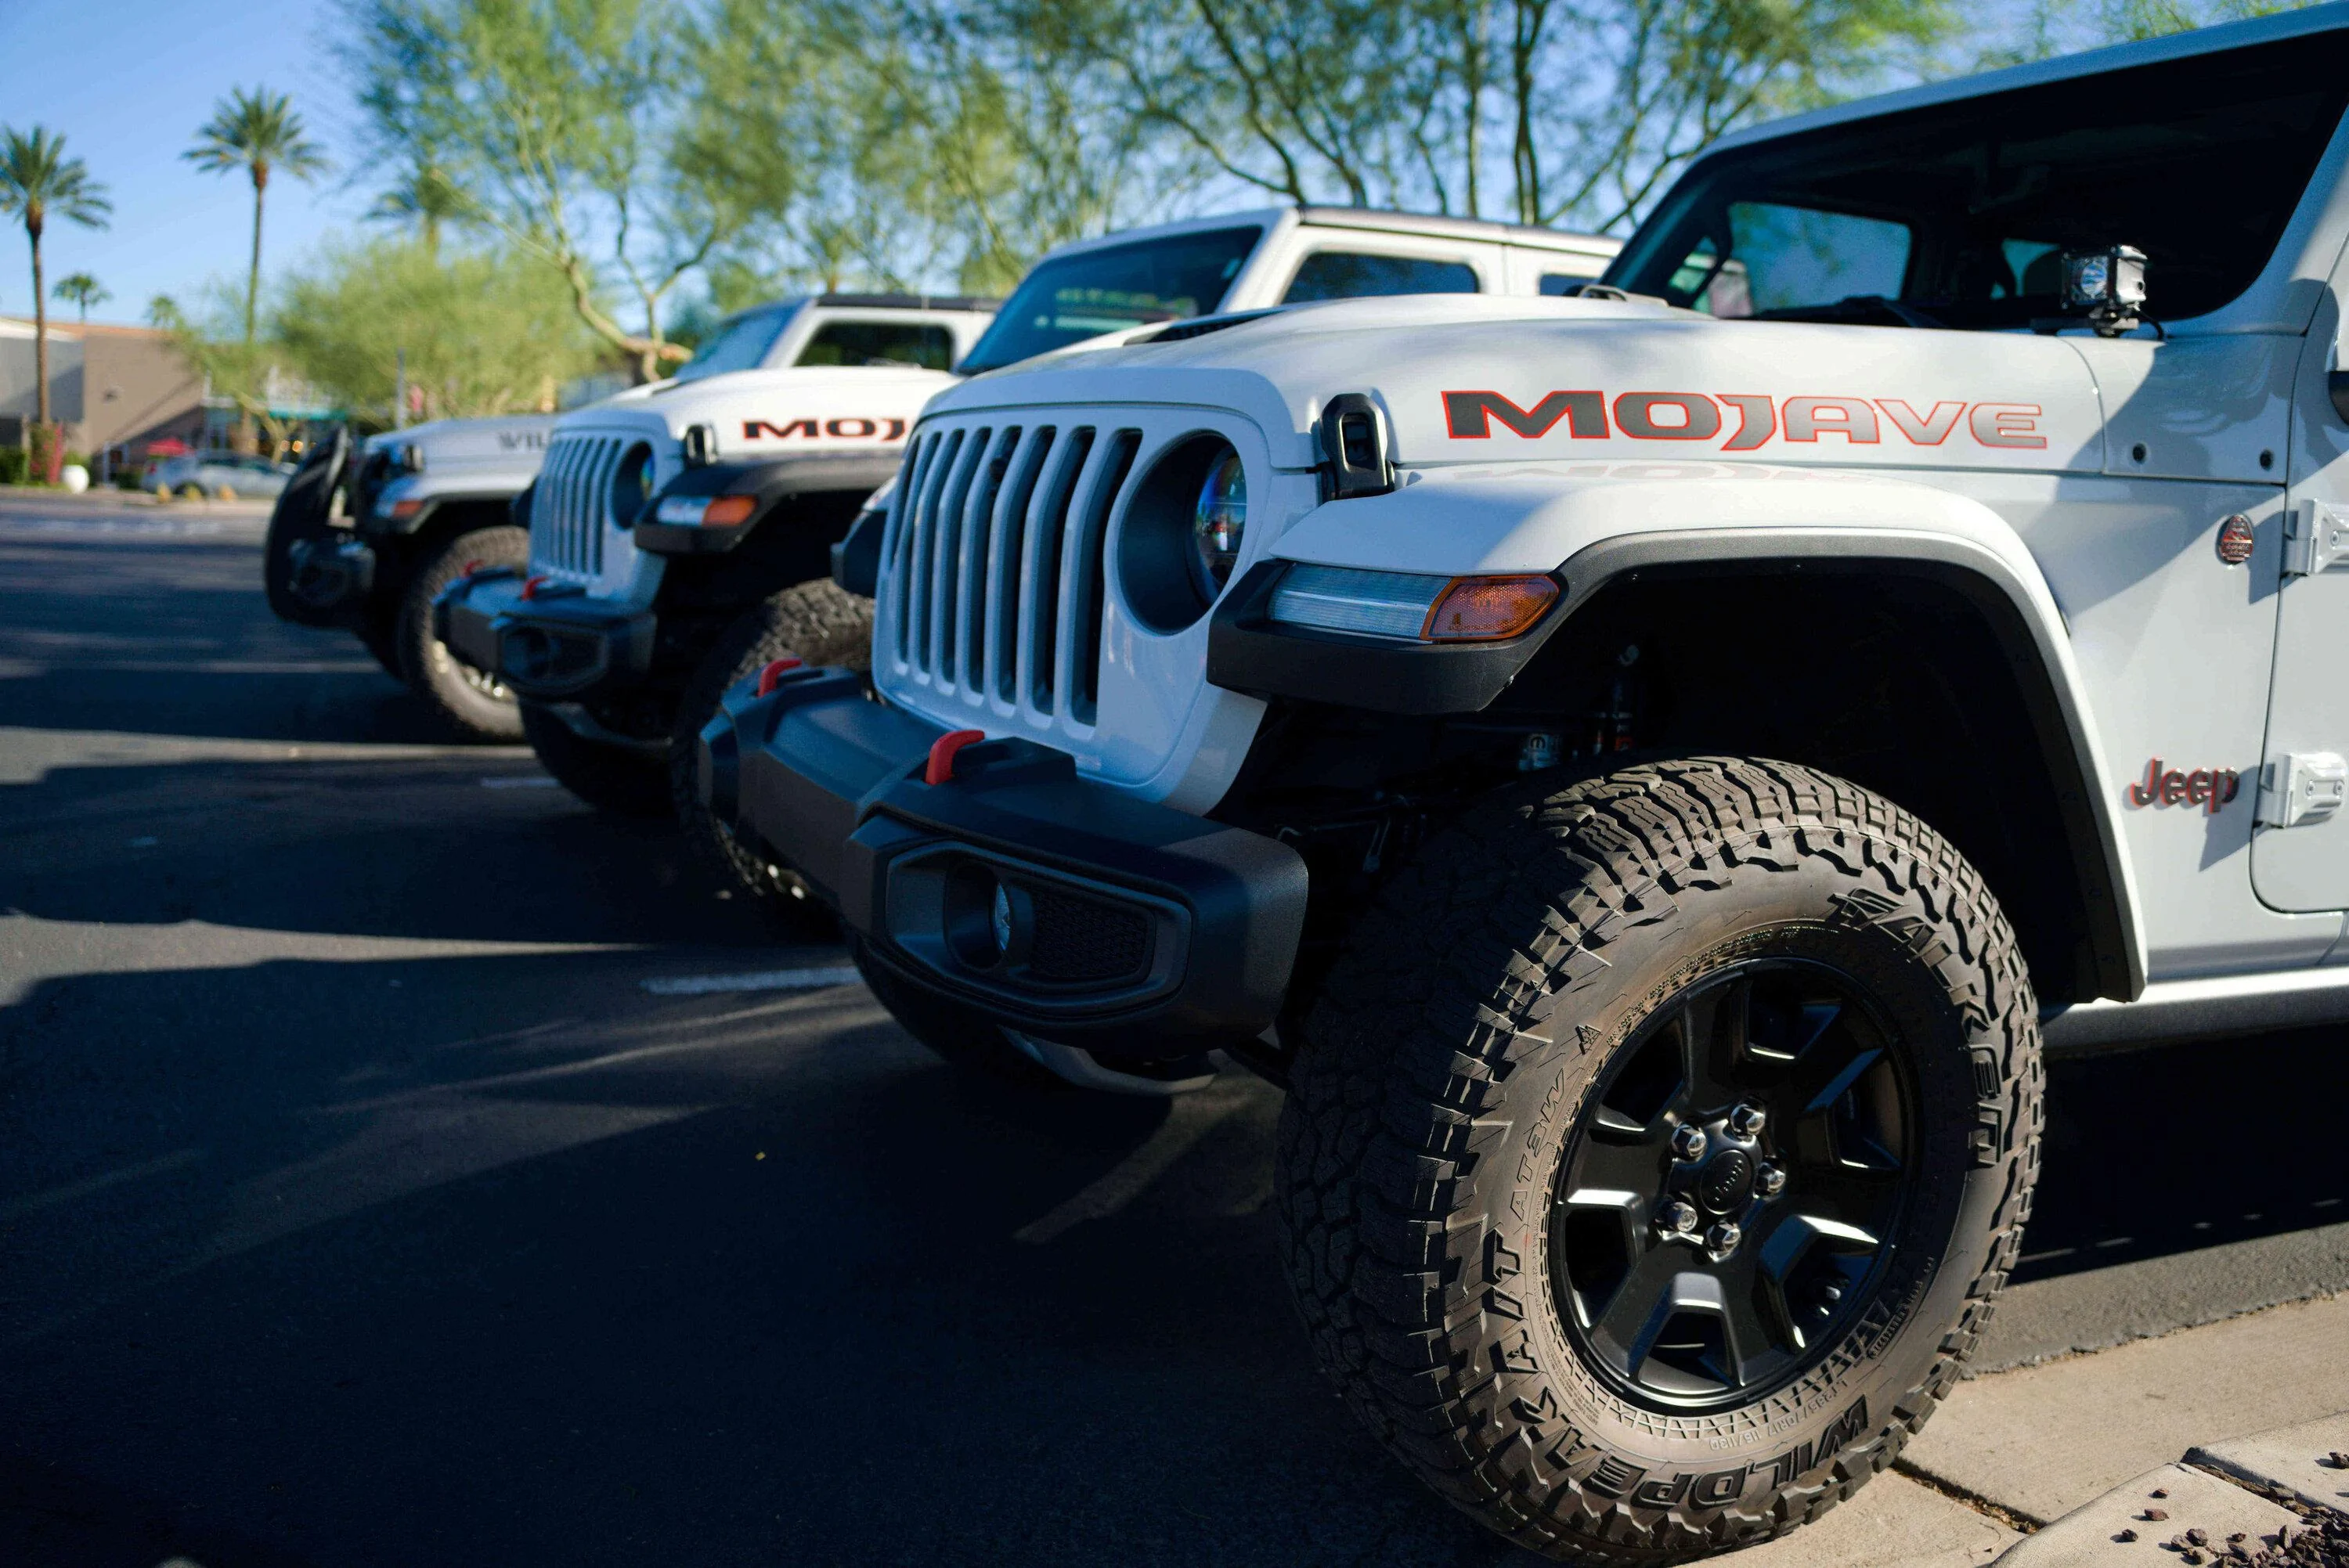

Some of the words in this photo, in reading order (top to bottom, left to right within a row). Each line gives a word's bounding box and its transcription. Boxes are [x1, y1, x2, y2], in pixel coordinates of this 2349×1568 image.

[1440, 390, 2048, 452] MOJAVE
[2131, 755, 2239, 814] Jeep
[1507, 1386, 1869, 1510] WILDPEAK
